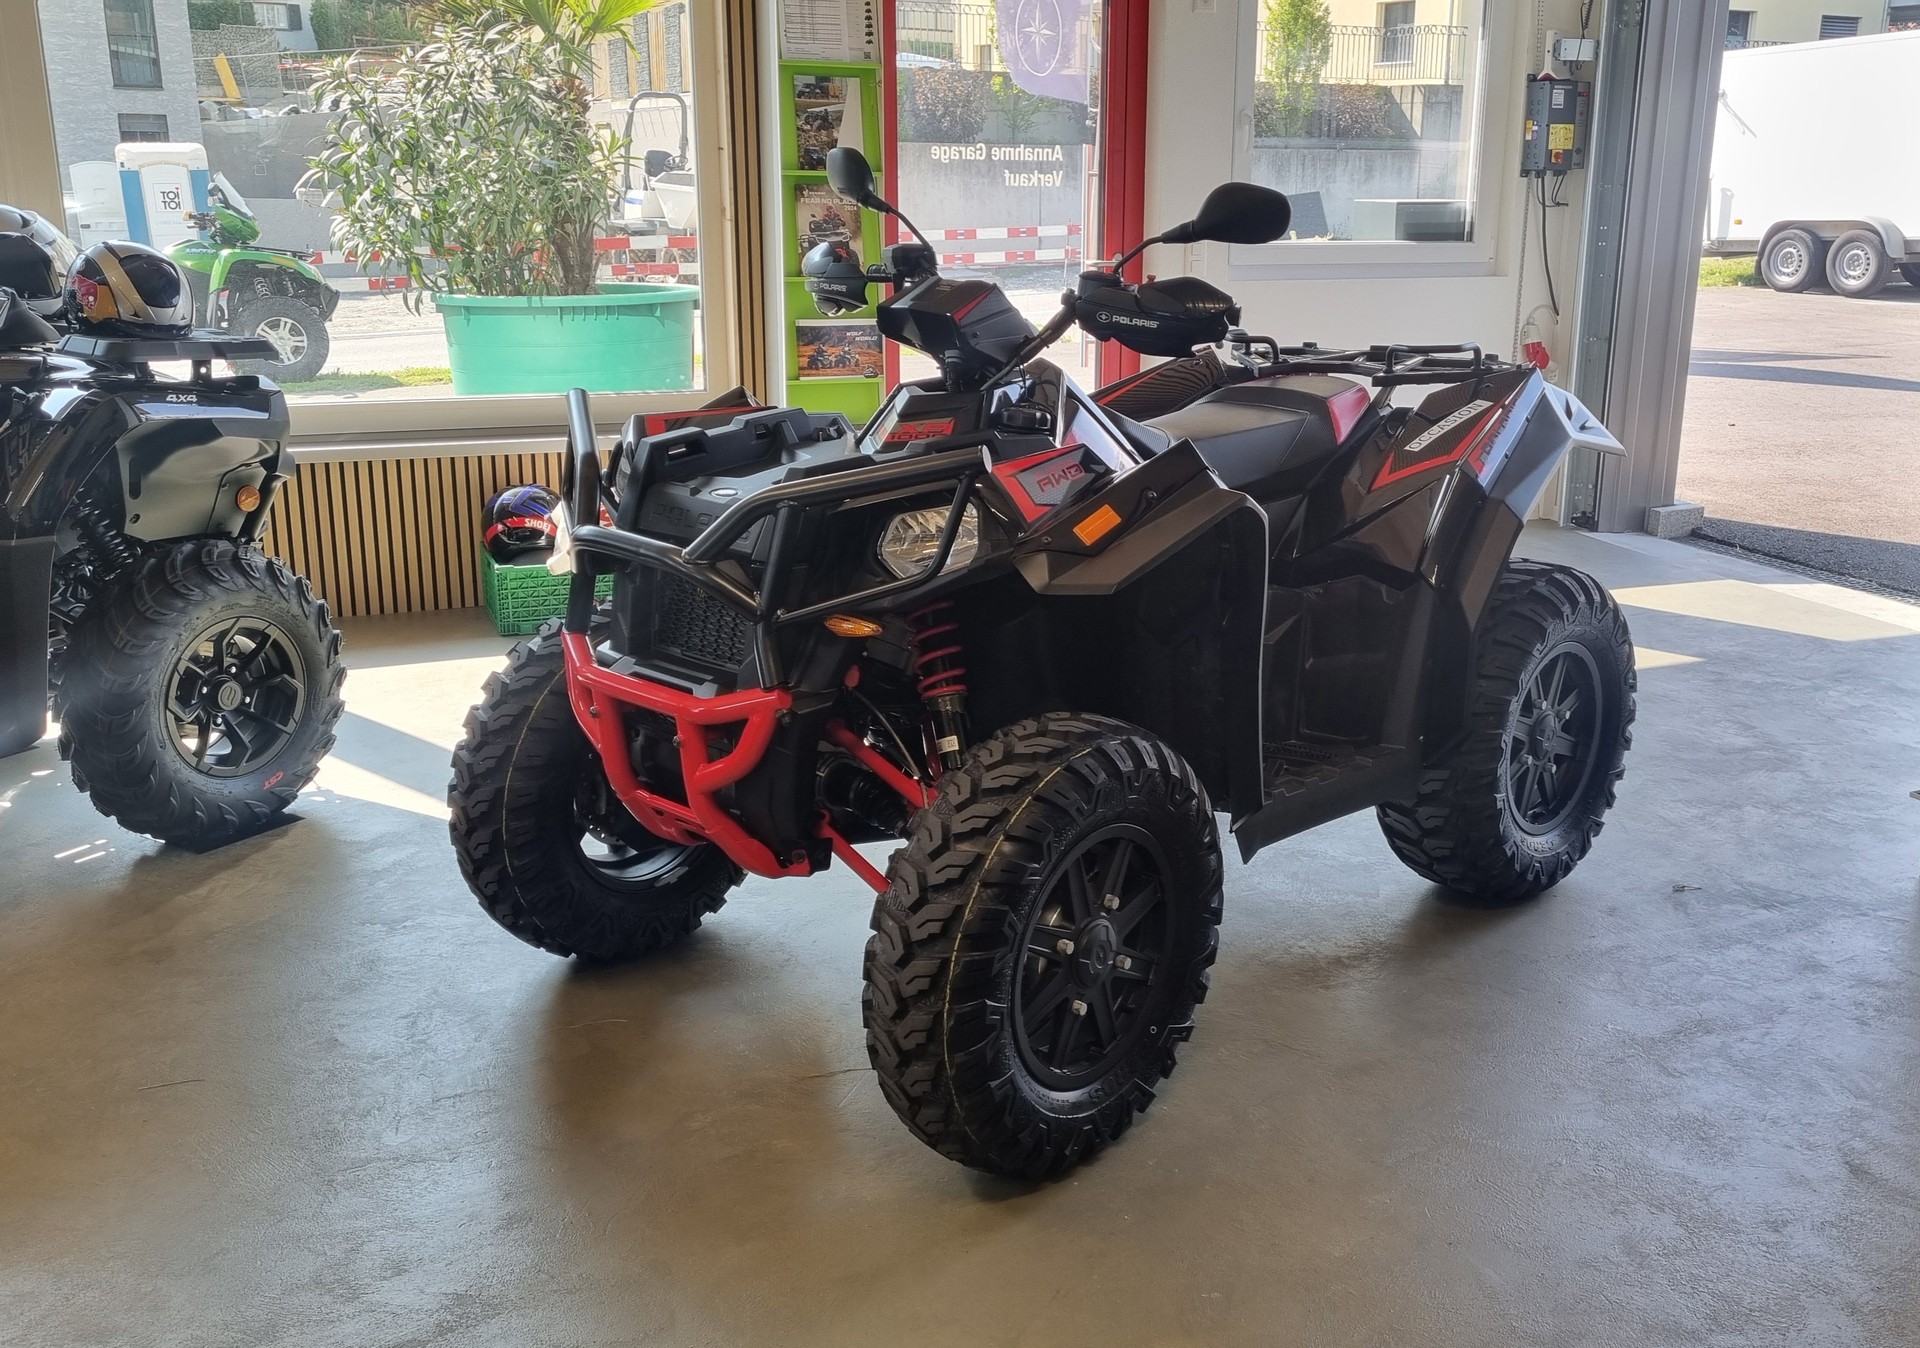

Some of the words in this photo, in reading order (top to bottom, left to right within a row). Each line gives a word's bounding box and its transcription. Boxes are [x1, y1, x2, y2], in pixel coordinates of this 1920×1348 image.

[161, 201, 181, 210] TOI
[820, 282, 847, 292] POLARIS
[1112, 315, 1159, 328] POLARIS
[1408, 402, 1484, 450] OCCASION
[1036, 463, 1084, 493] AWD
[524, 518, 551, 533] SHOEI
[262, 770, 284, 790] CST
